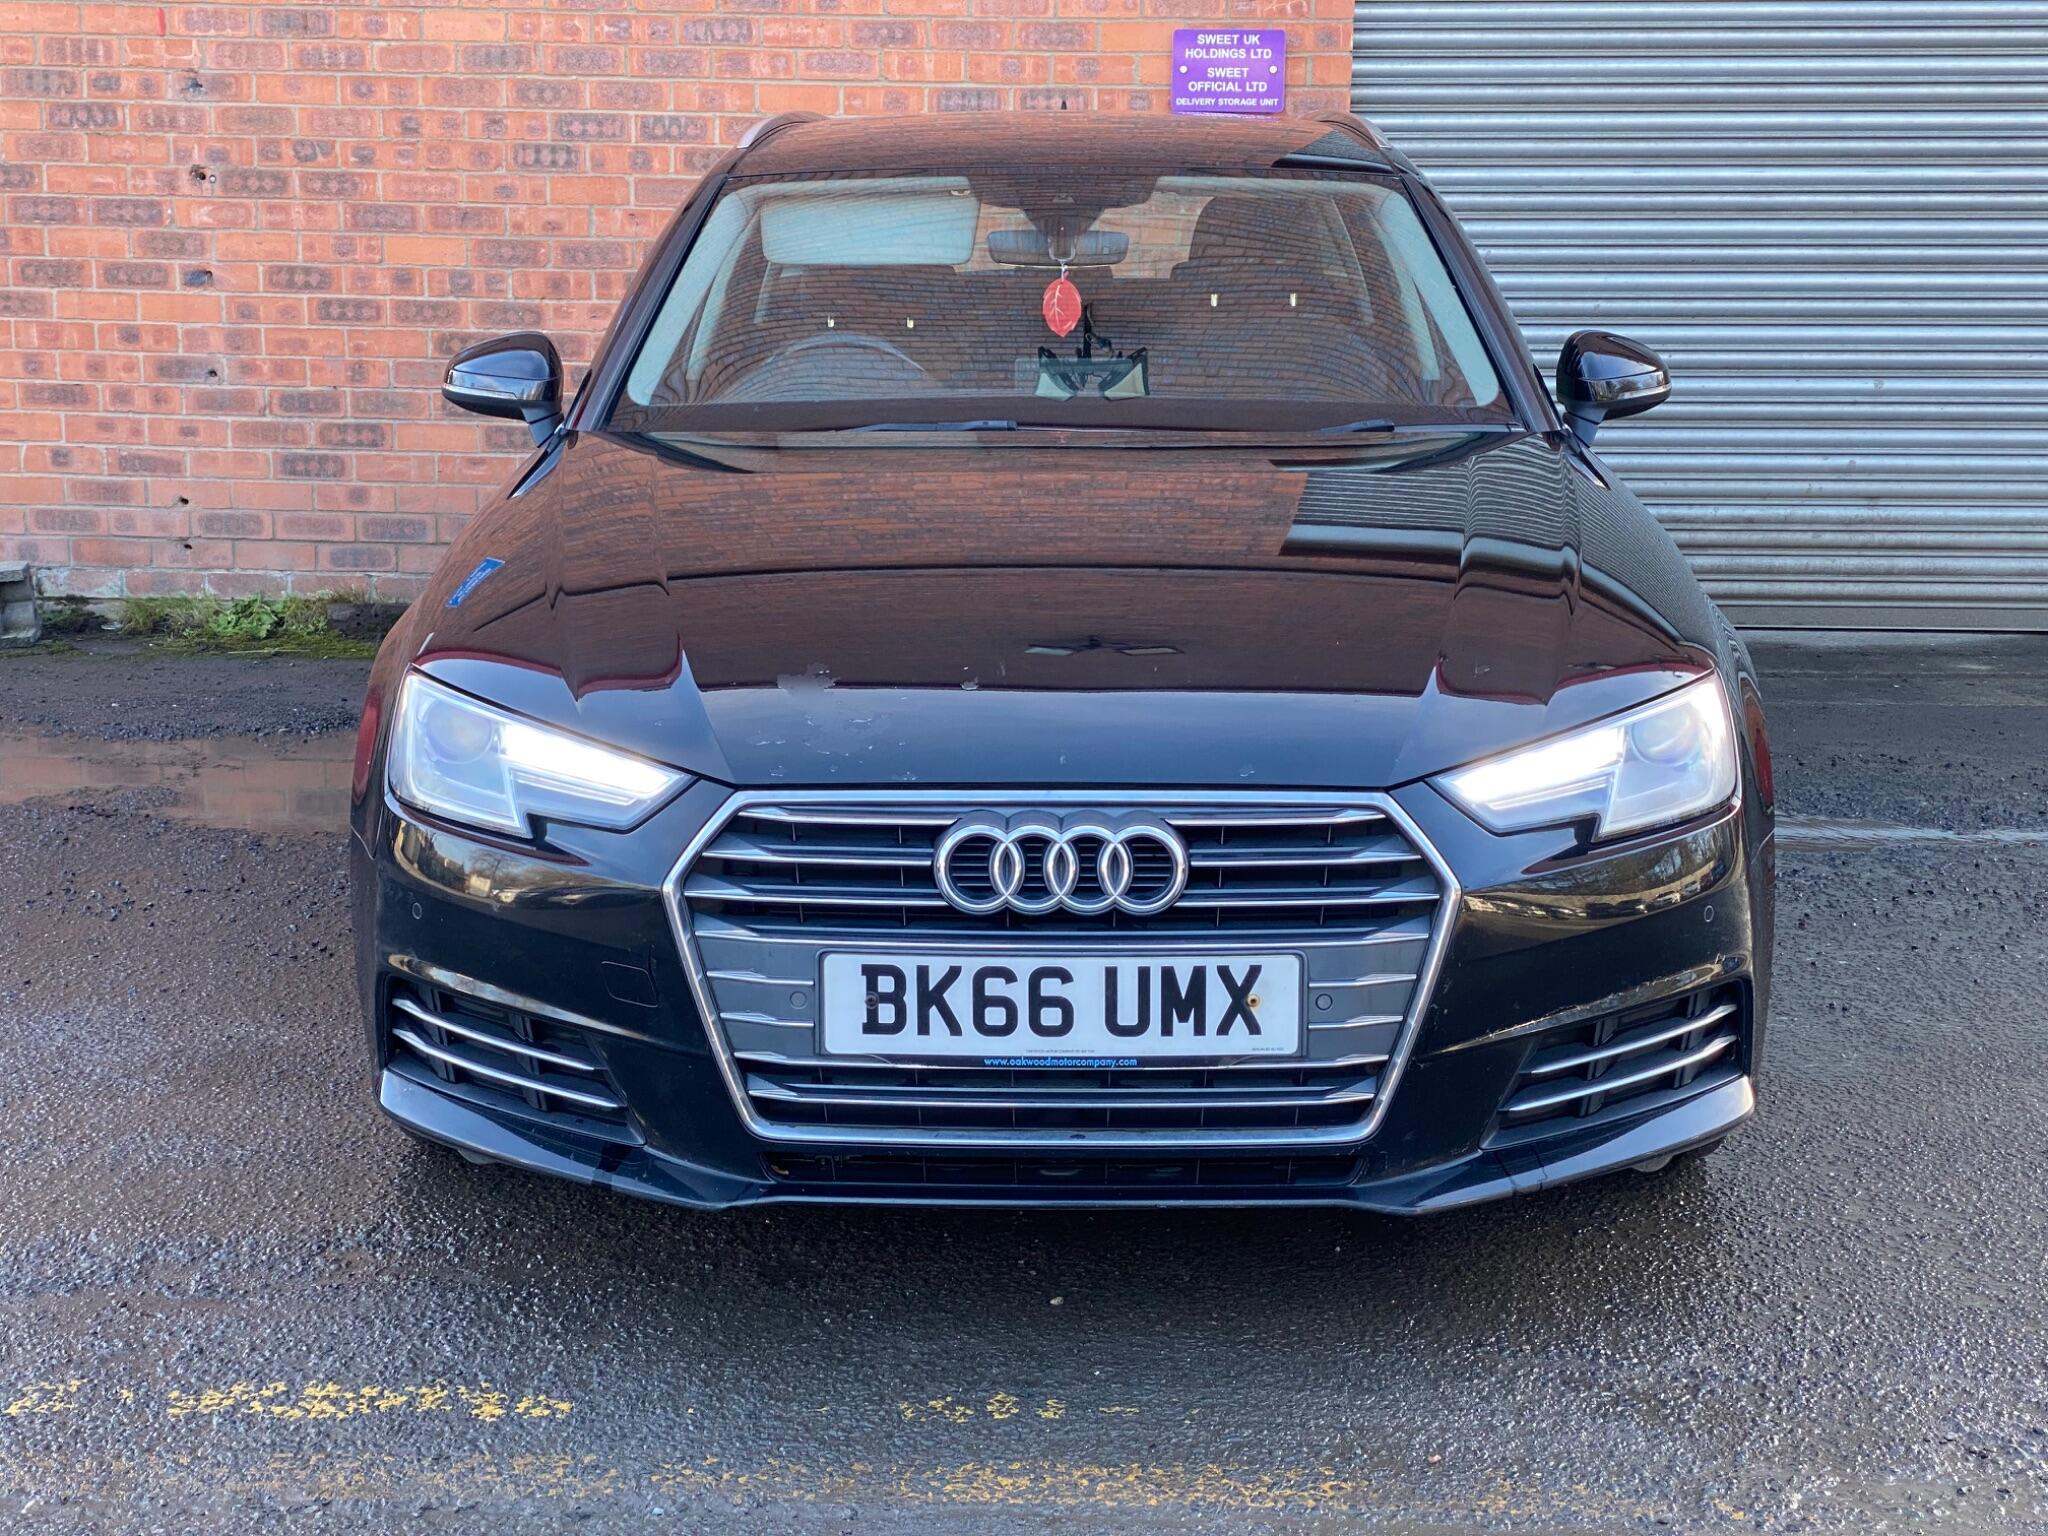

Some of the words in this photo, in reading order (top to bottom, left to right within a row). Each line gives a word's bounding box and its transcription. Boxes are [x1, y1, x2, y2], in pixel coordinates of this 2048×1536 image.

[1197, 34, 1240, 45] SWEET
[1243, 34, 1260, 45] UK
[1185, 48, 1246, 59] HOLDINGS
[1250, 48, 1272, 59] LTD
[1207, 67, 1249, 78] SWEET
[1188, 81, 1242, 92] OFFICIAL
[1246, 81, 1268, 92] LTD
[1175, 98, 1216, 106] DELIVERY
[1218, 98, 1257, 106] STORAGE
[1260, 98, 1279, 106] UNIT
[861, 964, 1074, 1038] BK66
[1104, 964, 1263, 1038] UMX
[983, 1056, 1138, 1068] www.oakwoodmotorcompany.com
